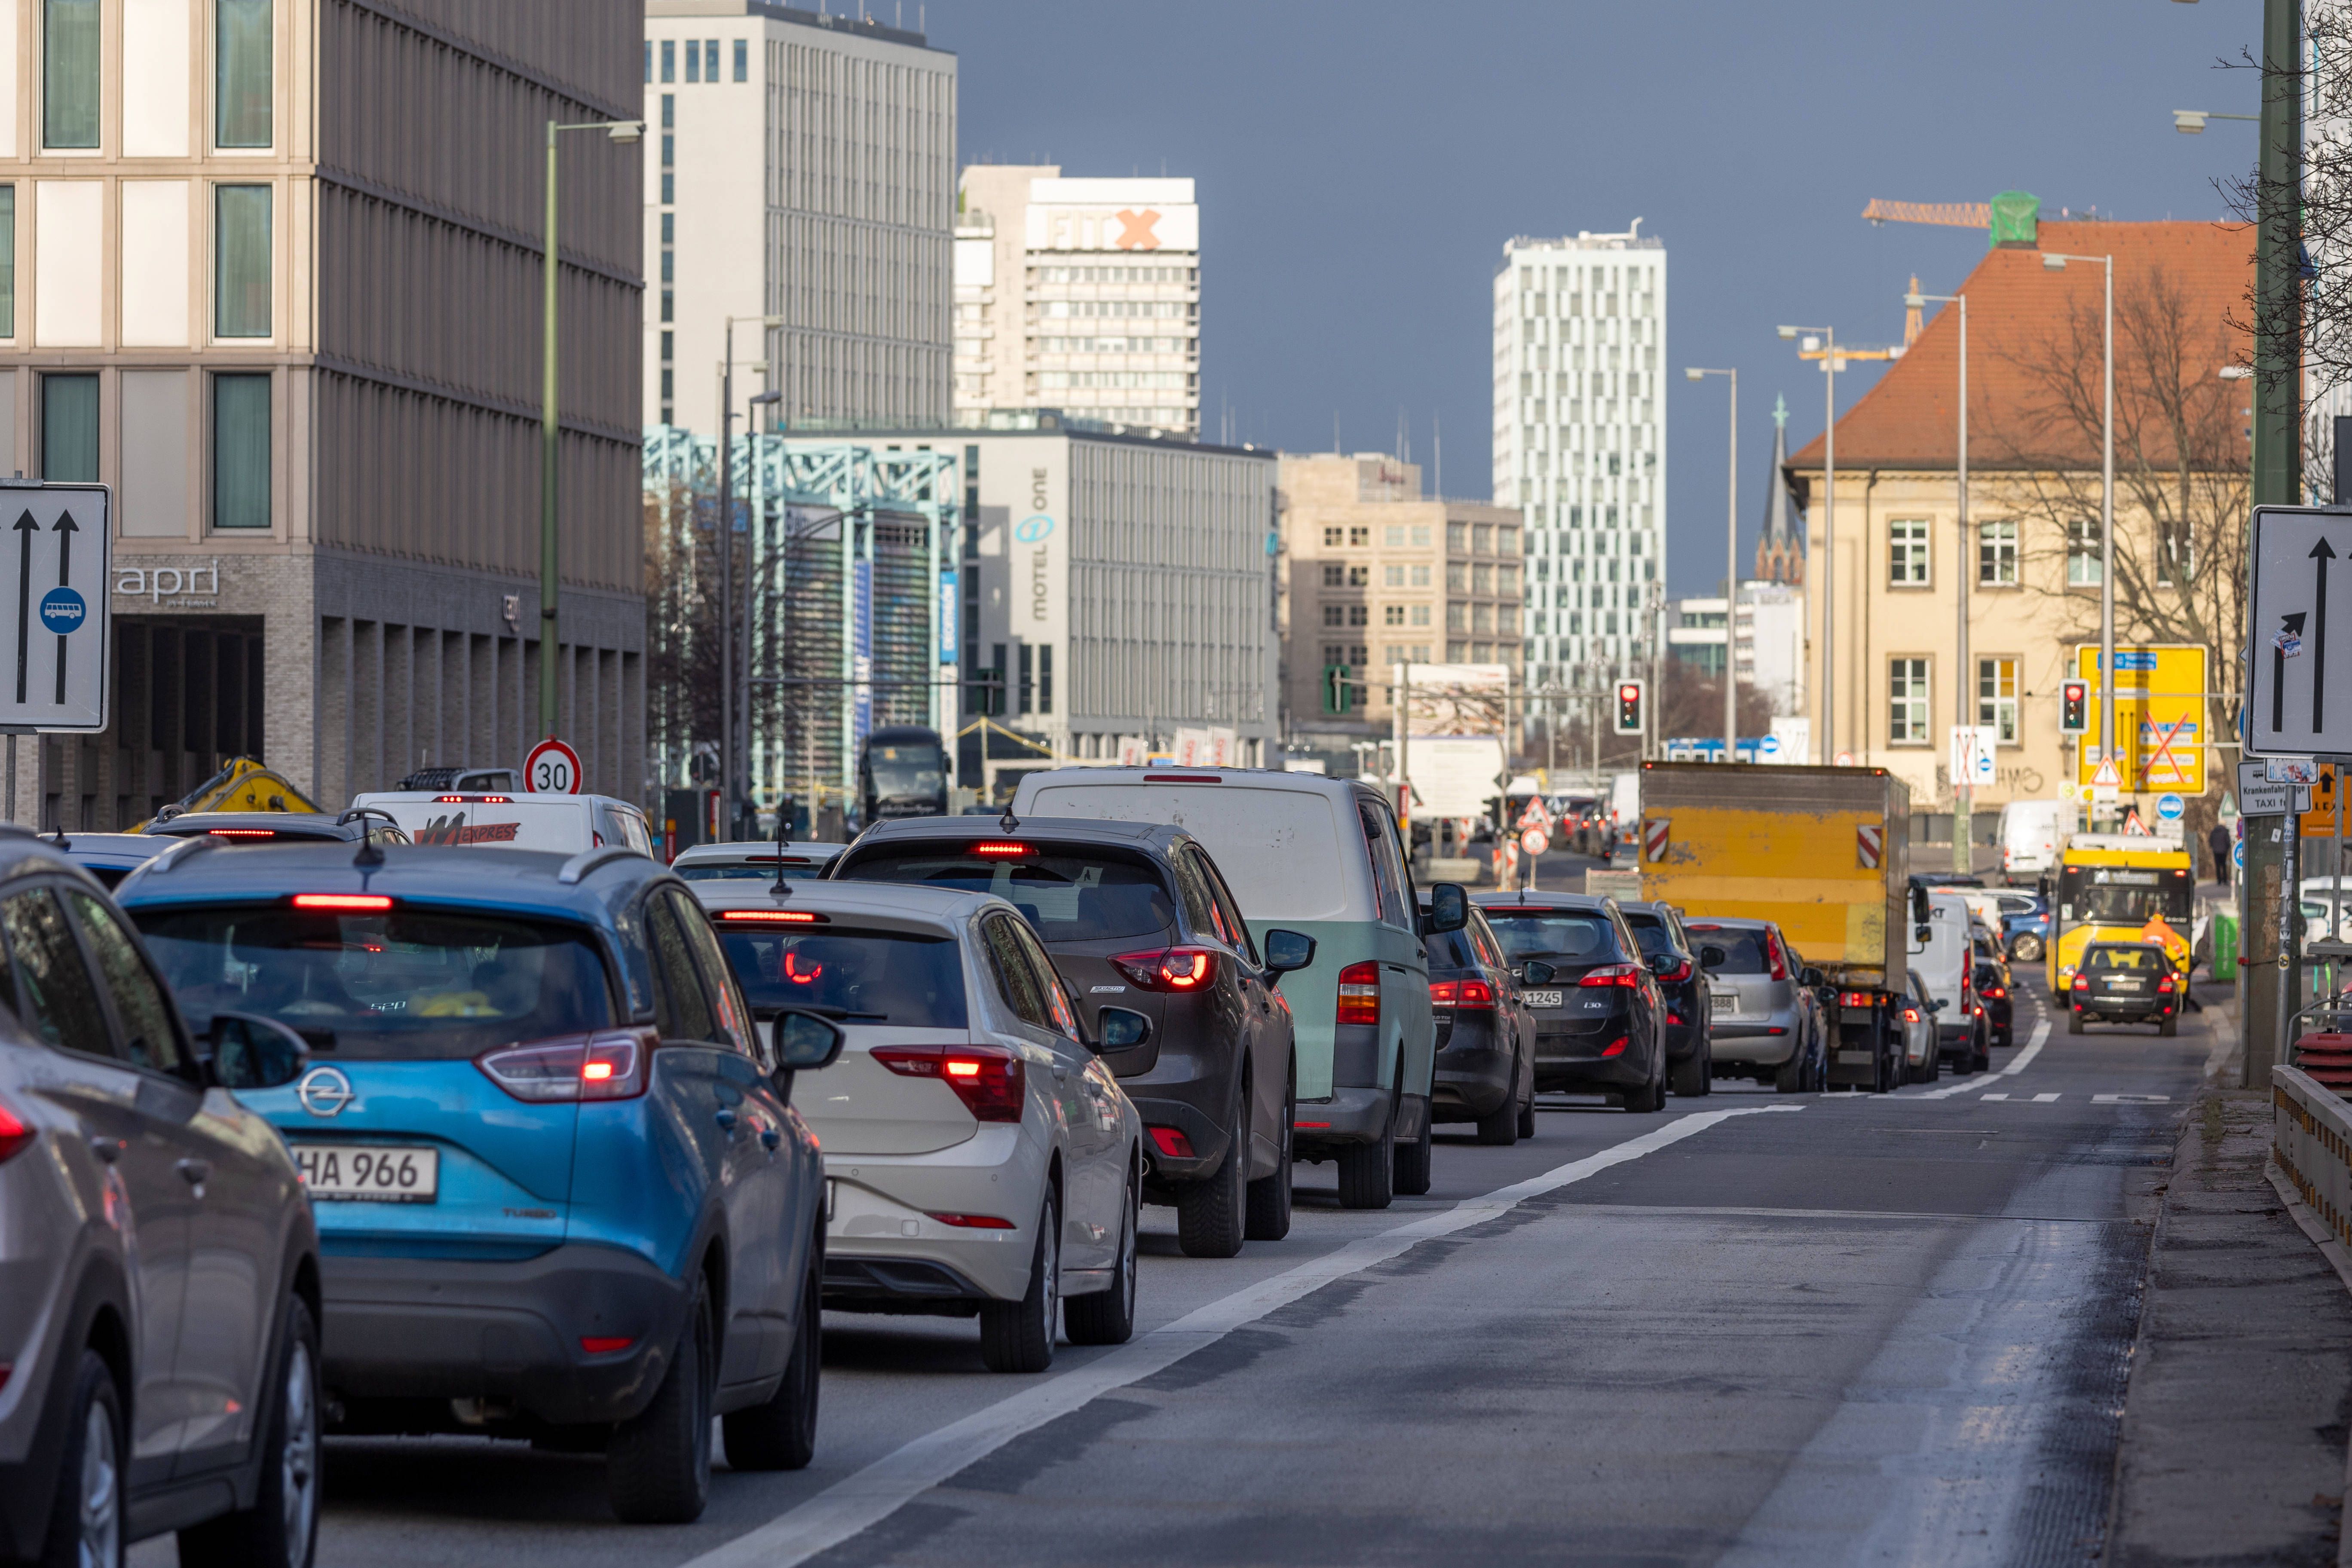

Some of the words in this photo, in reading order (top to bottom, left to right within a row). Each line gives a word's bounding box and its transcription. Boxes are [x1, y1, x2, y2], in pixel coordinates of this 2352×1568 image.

[537, 763, 567, 790] 30
[2243, 785, 2305, 795] Krankenfahrge
[2255, 798, 2275, 808] TAXI
[1528, 992, 1560, 1004] 1245
[297, 1151, 341, 1185] HA
[353, 1152, 418, 1187] 966
